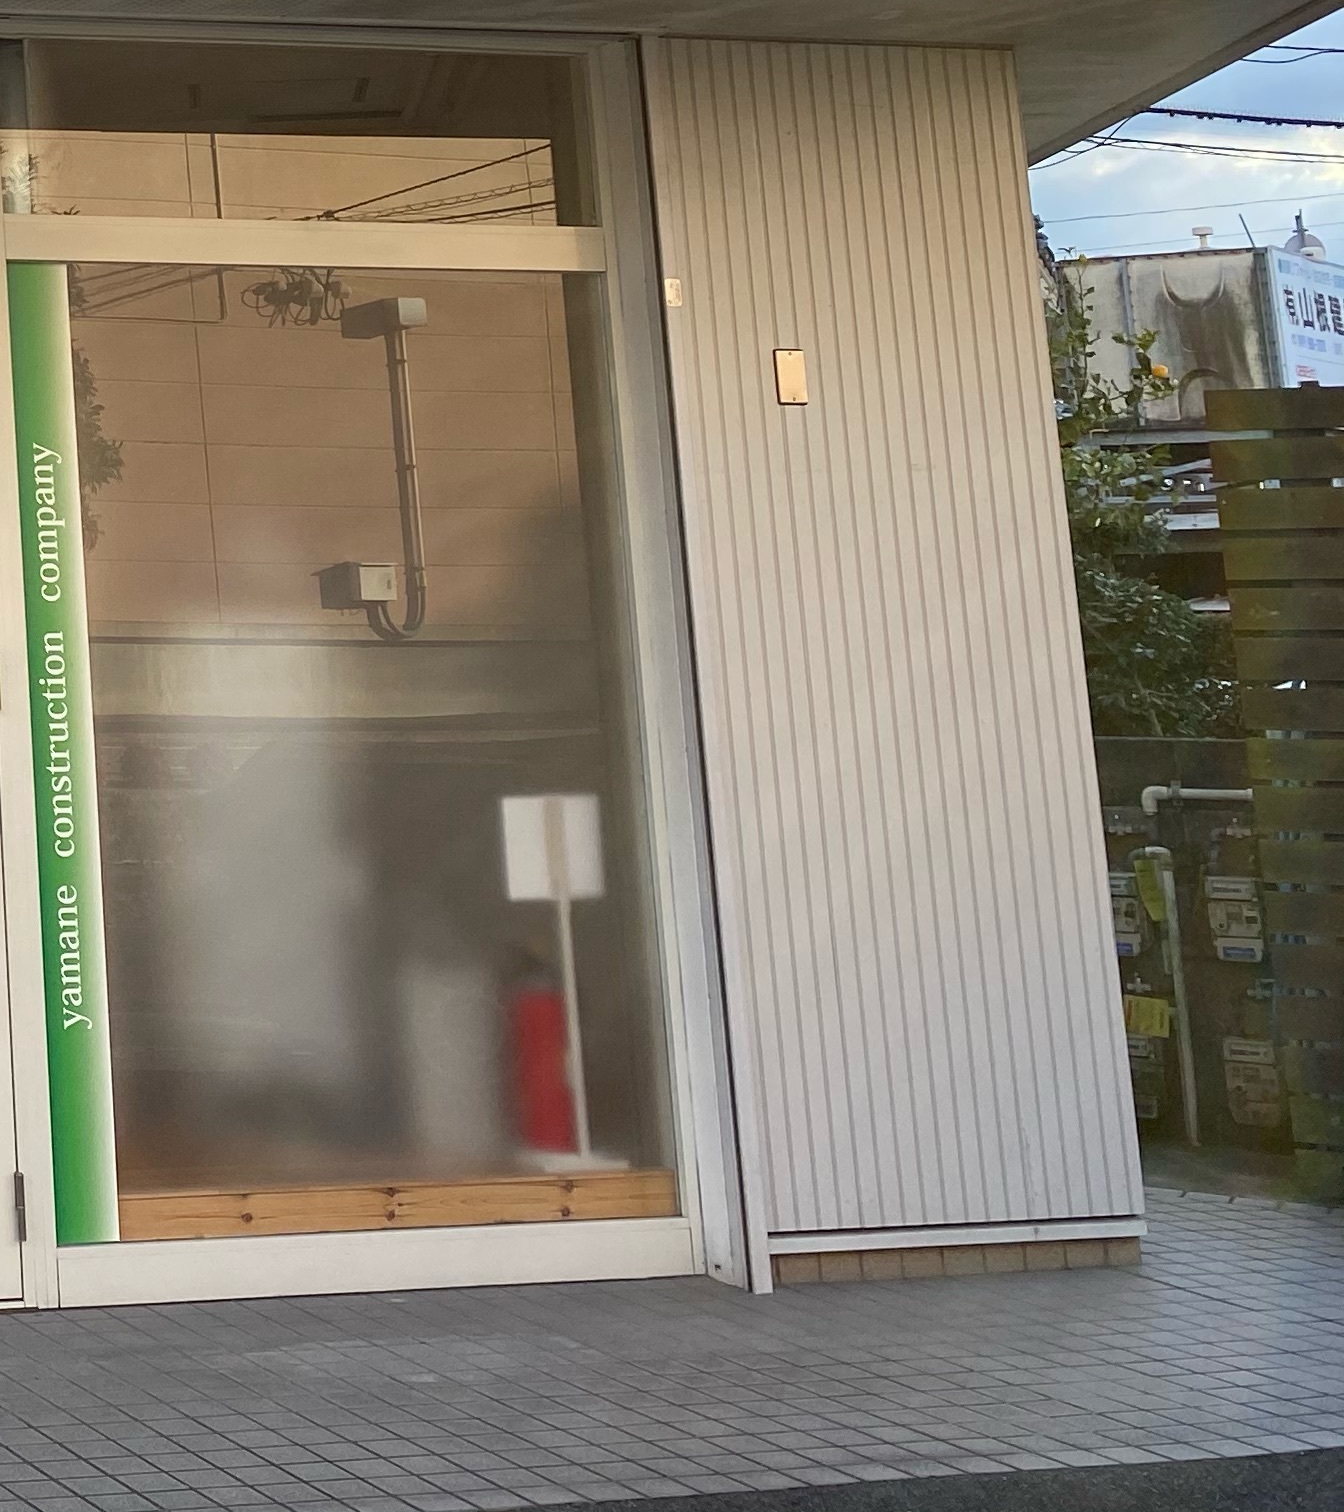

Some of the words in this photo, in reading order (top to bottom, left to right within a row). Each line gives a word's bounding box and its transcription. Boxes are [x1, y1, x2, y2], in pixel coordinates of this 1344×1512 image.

[32, 442, 63, 603] company
[39, 630, 77, 858] construction
[59, 883, 93, 1029] yamane
